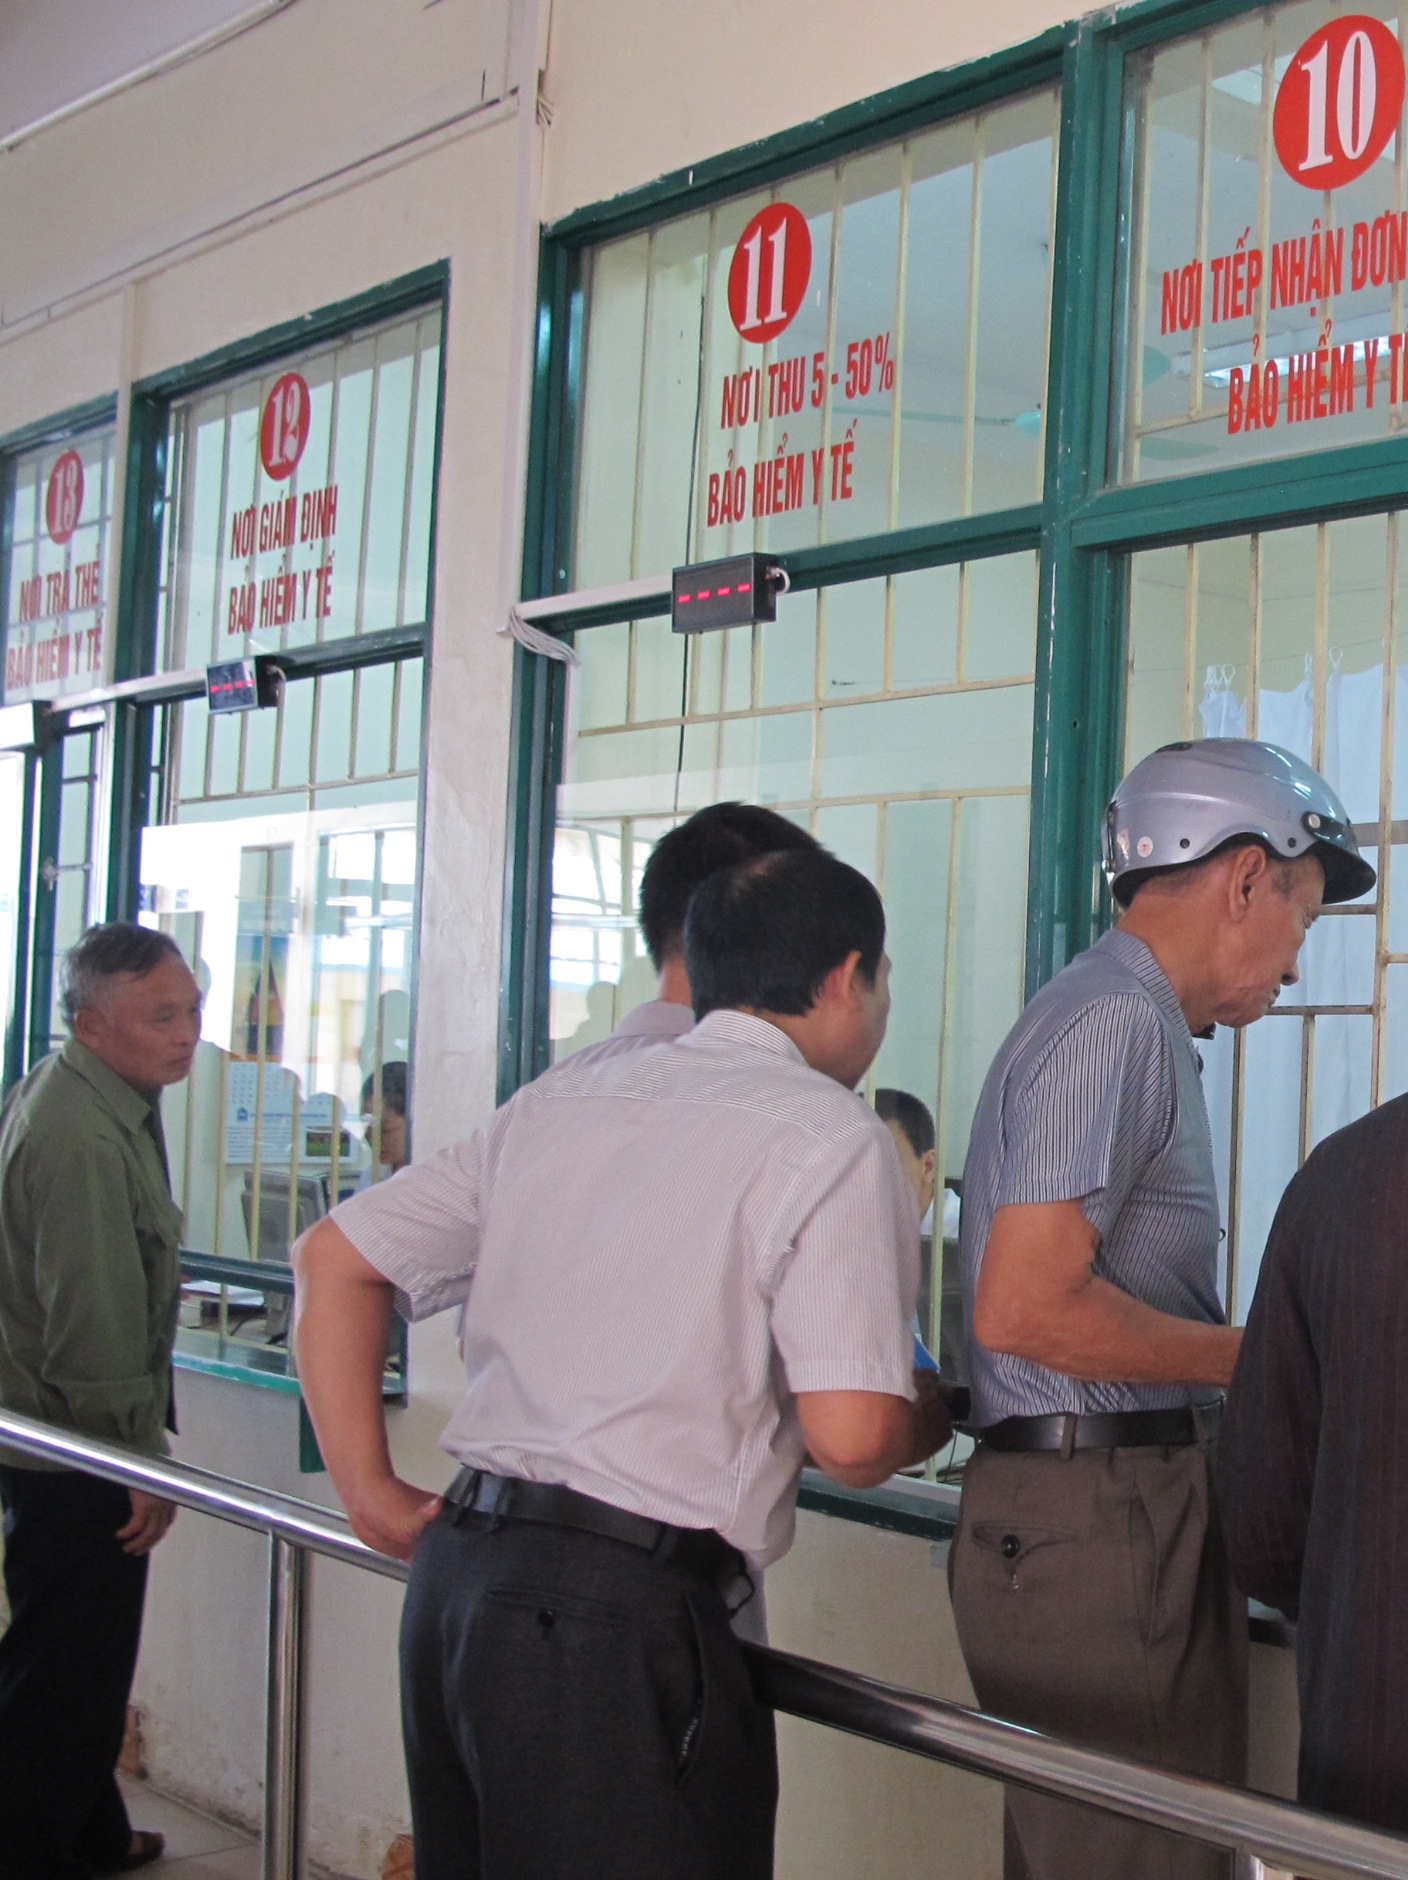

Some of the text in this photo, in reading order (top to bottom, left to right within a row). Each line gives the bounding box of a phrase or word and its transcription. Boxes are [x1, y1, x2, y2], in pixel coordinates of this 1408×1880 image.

[1298, 30, 1378, 172] 10
[739, 217, 788, 332] 11
[1160, 258, 1204, 336] NƠI
[1210, 226, 1264, 324] TIẾP
[1269, 218, 1345, 318] NHẬN
[1350, 209, 1408, 293] ĐƠN
[268, 381, 301, 468] 12
[720, 365, 761, 430] NƠI
[767, 355, 807, 419] THU
[811, 351, 826, 408] 5
[845, 331, 895, 399] 50%
[1227, 333, 1280, 435] BẢO
[1285, 318, 1356, 424] HIỂM
[1364, 337, 1379, 409] Y
[230, 484, 339, 561] NƠI GIÁM ĐỊNH
[706, 418, 858, 528] BẢO HIỂM Y TẾ
[228, 550, 336, 636] BẢO HIỂM Y TẾ
